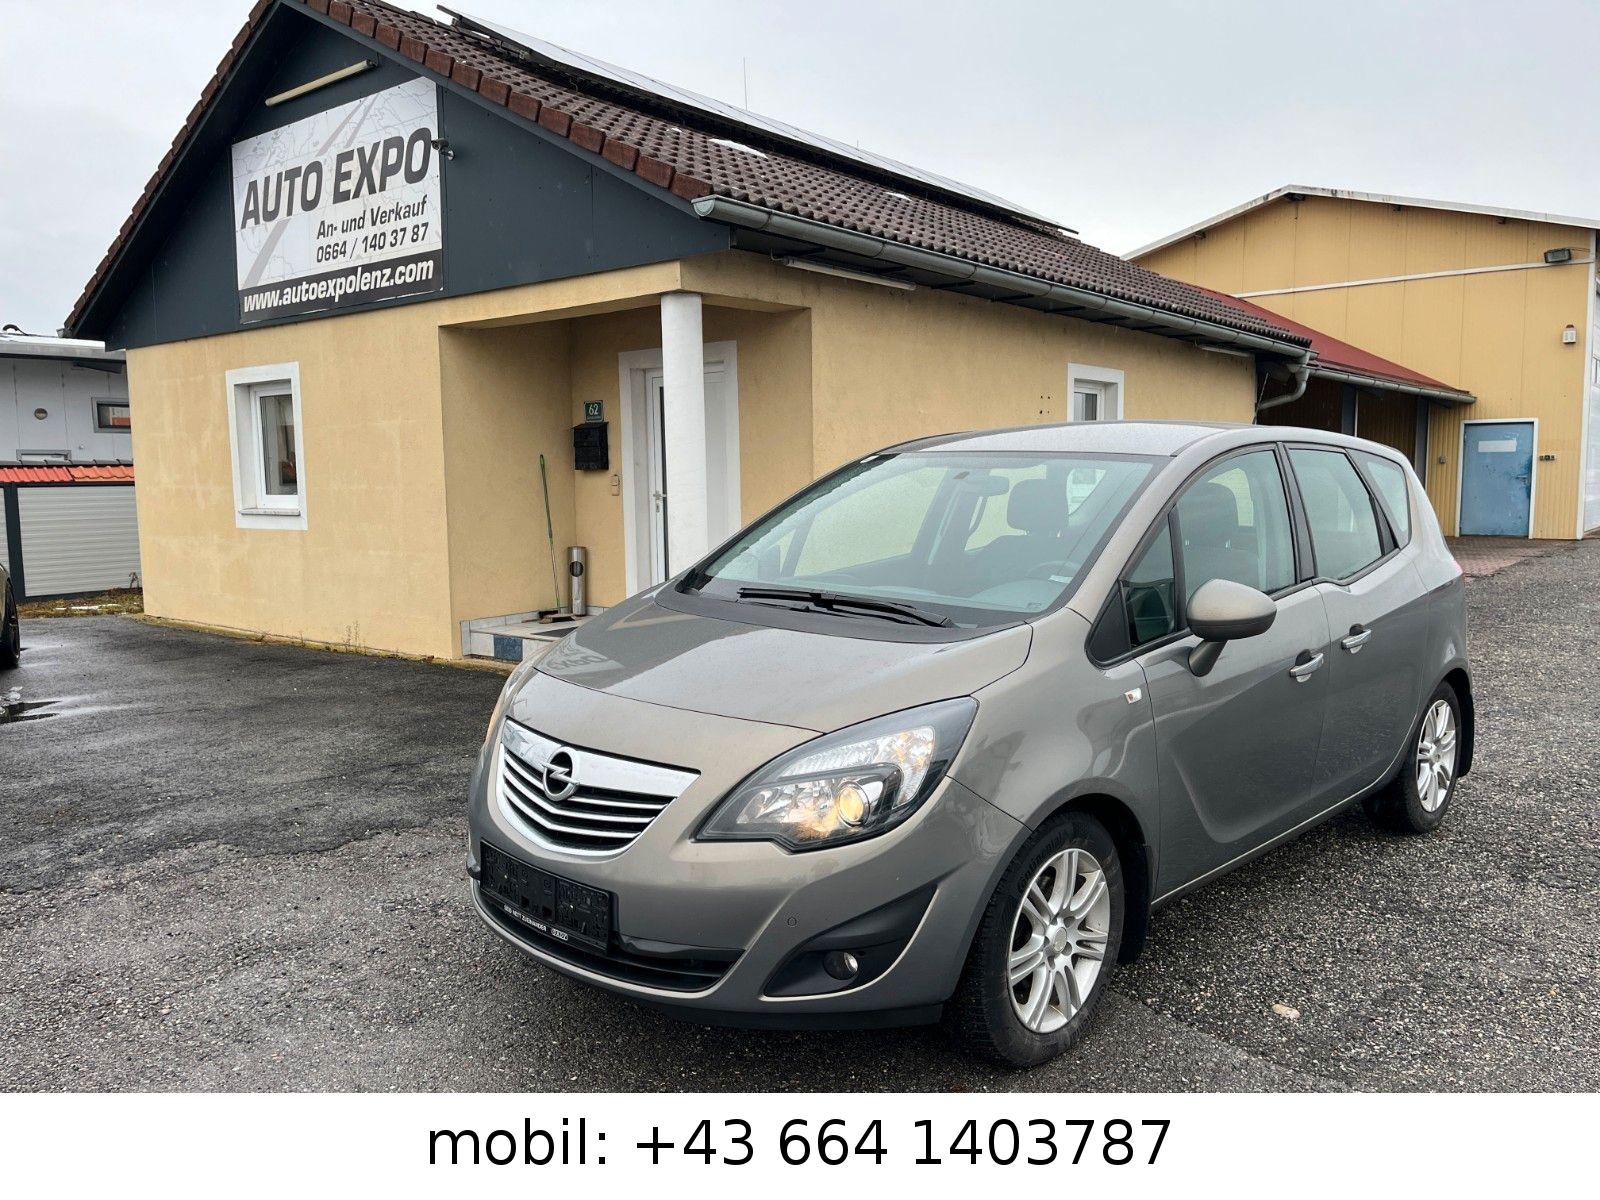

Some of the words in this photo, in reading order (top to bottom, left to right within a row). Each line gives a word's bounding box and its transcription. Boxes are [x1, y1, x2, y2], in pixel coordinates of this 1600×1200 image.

[240, 160, 323, 230] AUTO
[332, 127, 432, 205] EXPO
[316, 220, 339, 240] An-
[341, 210, 366, 234] und
[370, 194, 428, 227] Verkauf
[316, 241, 348, 264] 0664
[349, 238, 359, 260] /
[361, 231, 386, 254] 140
[389, 227, 406, 248] 37
[410, 222, 430, 243] 87
[243, 259, 434, 312] www.autoexpolenz.com
[588, 403, 599, 415] 62
